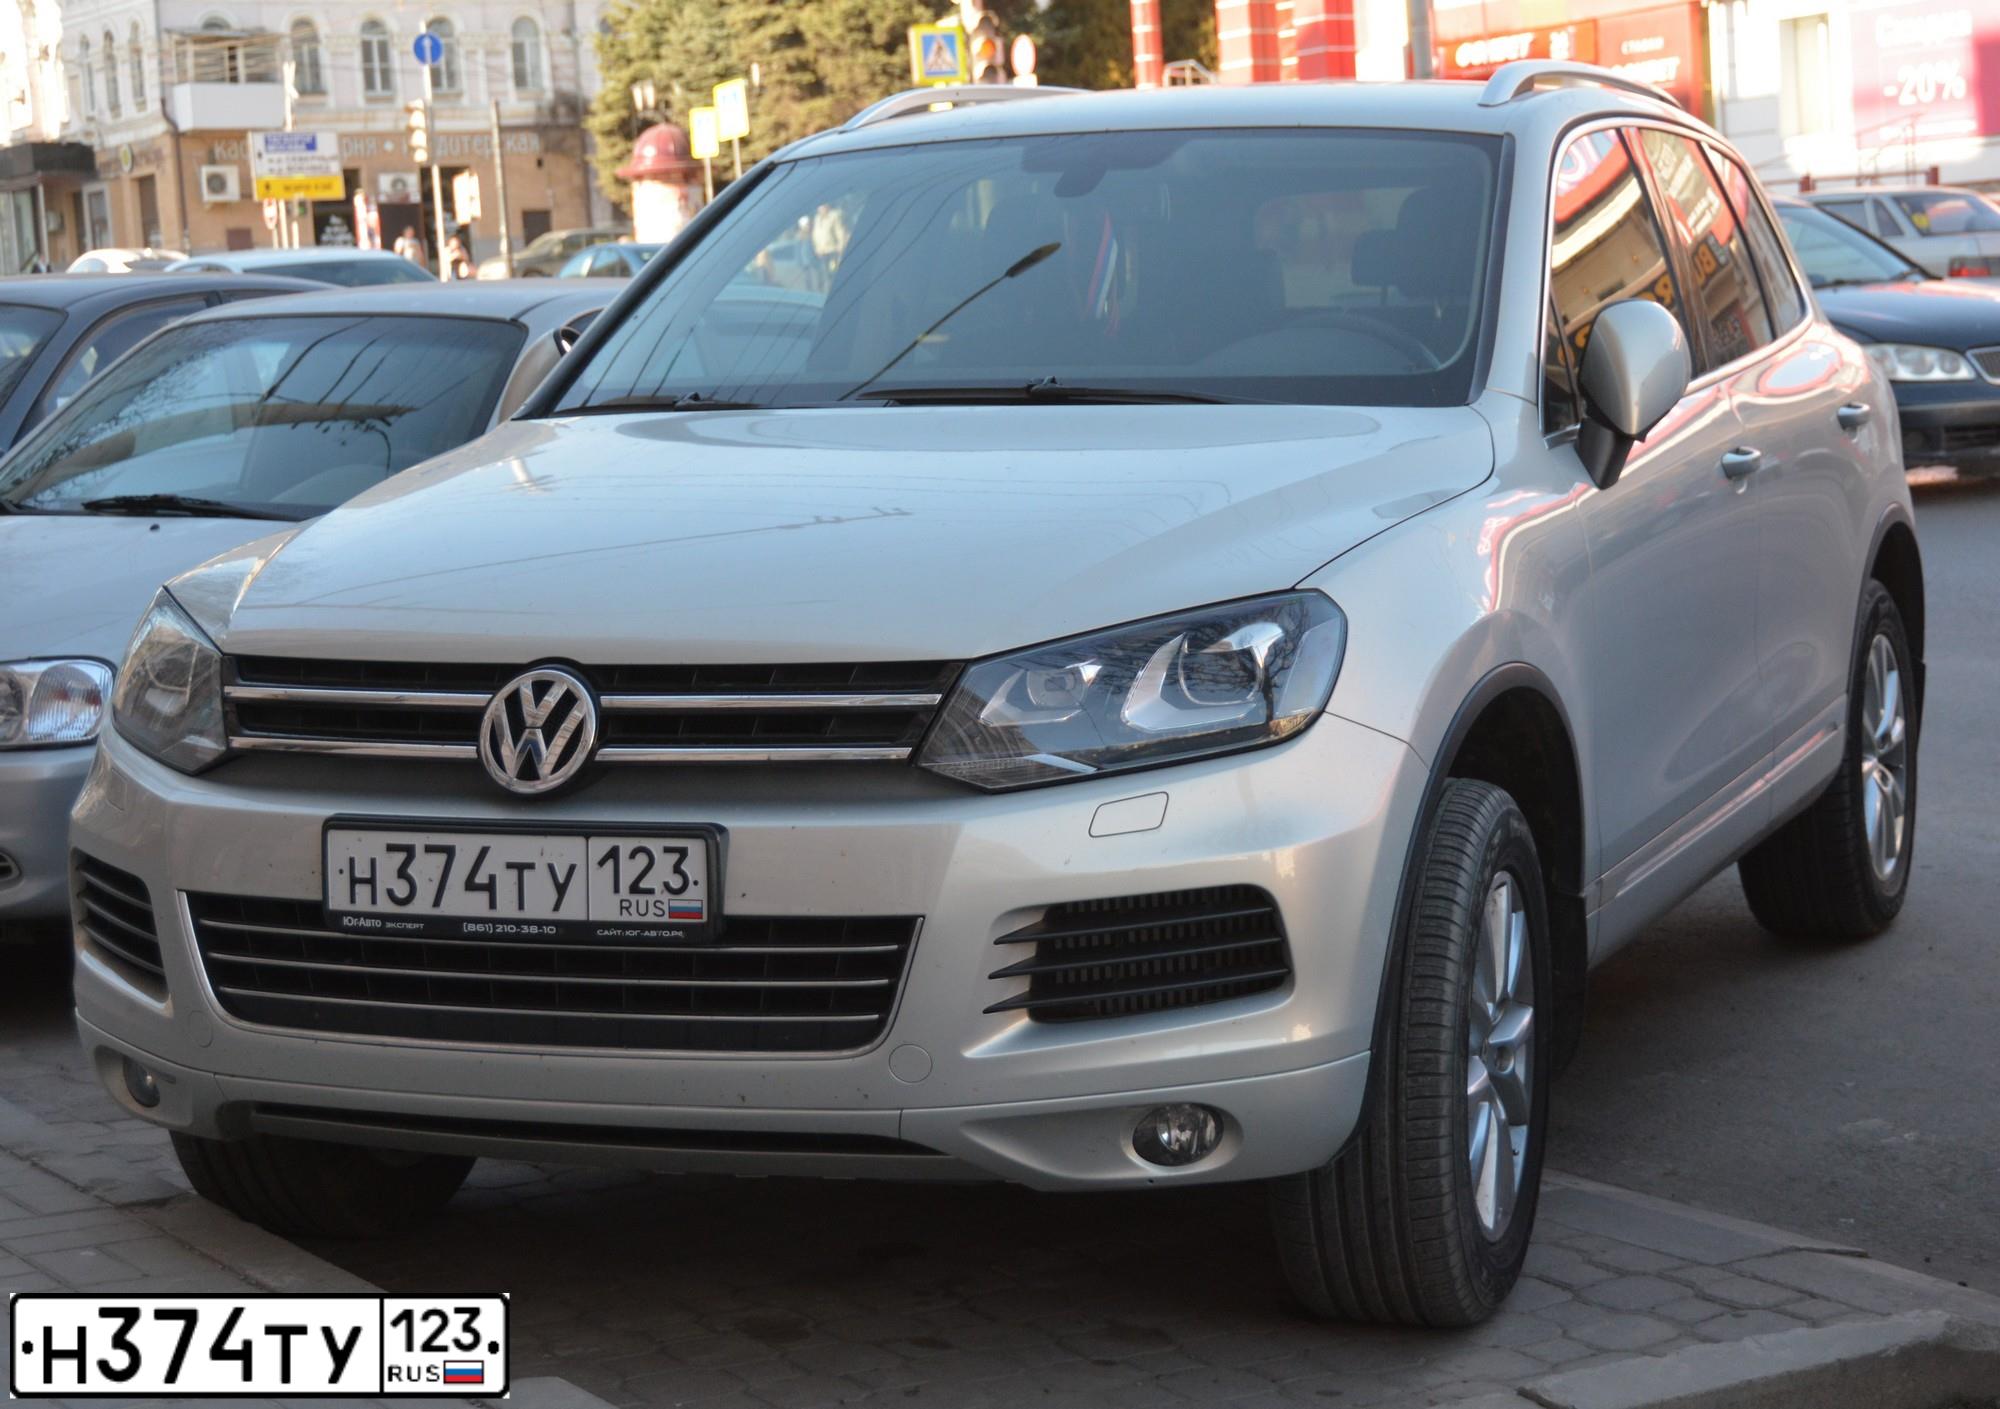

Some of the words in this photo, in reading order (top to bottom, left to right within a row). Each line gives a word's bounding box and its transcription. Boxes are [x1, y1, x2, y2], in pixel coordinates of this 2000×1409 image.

[349, 843, 577, 912] Н374ТУ
[597, 845, 690, 895] 123
[620, 899, 665, 917] RUS
[463, 922, 493, 933] (861)
[495, 924, 557, 934] 210-38-10
